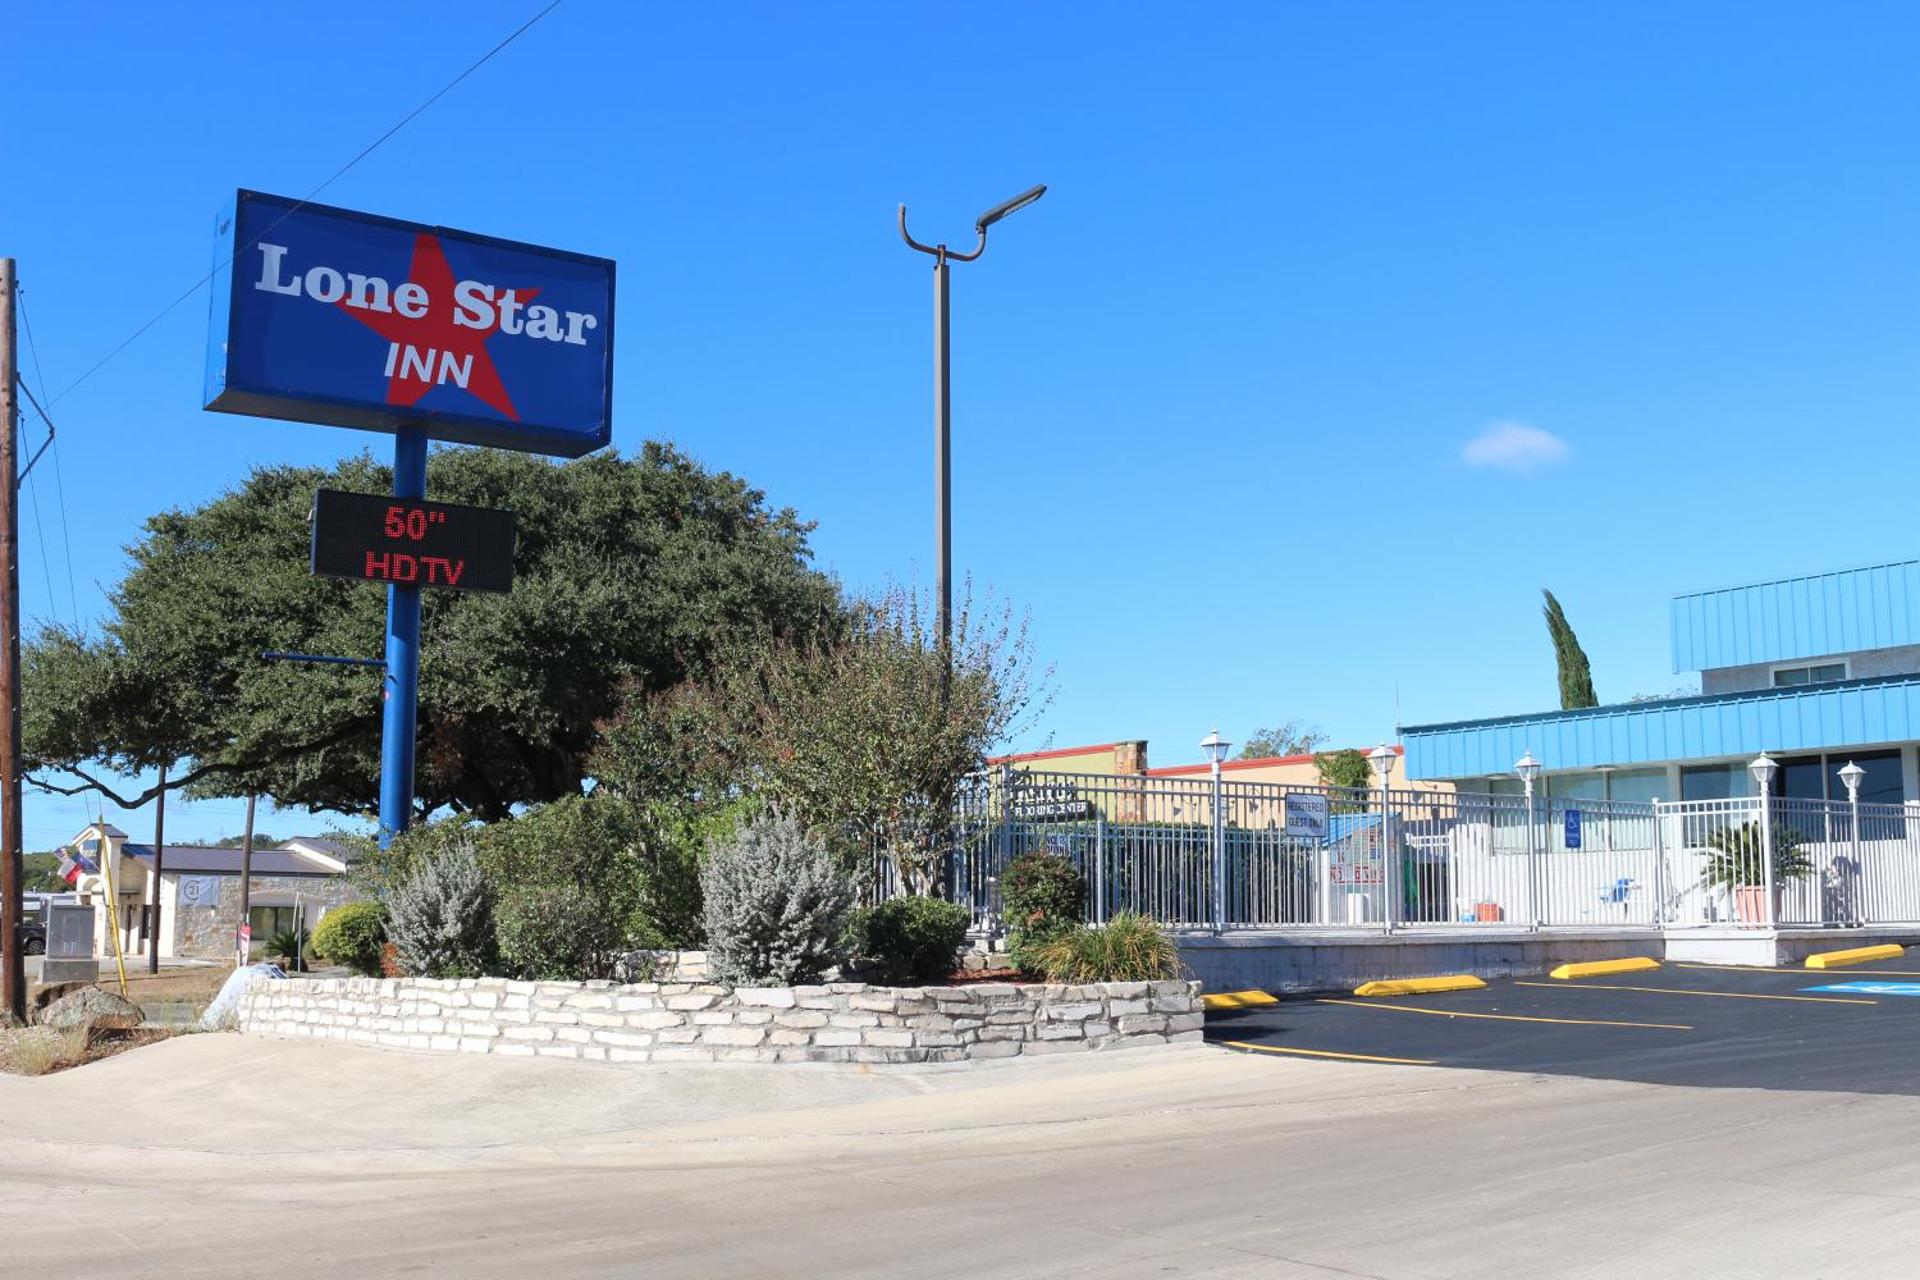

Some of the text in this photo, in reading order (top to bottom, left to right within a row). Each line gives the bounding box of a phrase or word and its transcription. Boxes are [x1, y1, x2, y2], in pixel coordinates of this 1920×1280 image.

[255, 242, 598, 346] Lone Star
[384, 342, 474, 389] INN
[365, 550, 464, 585] HDTV
